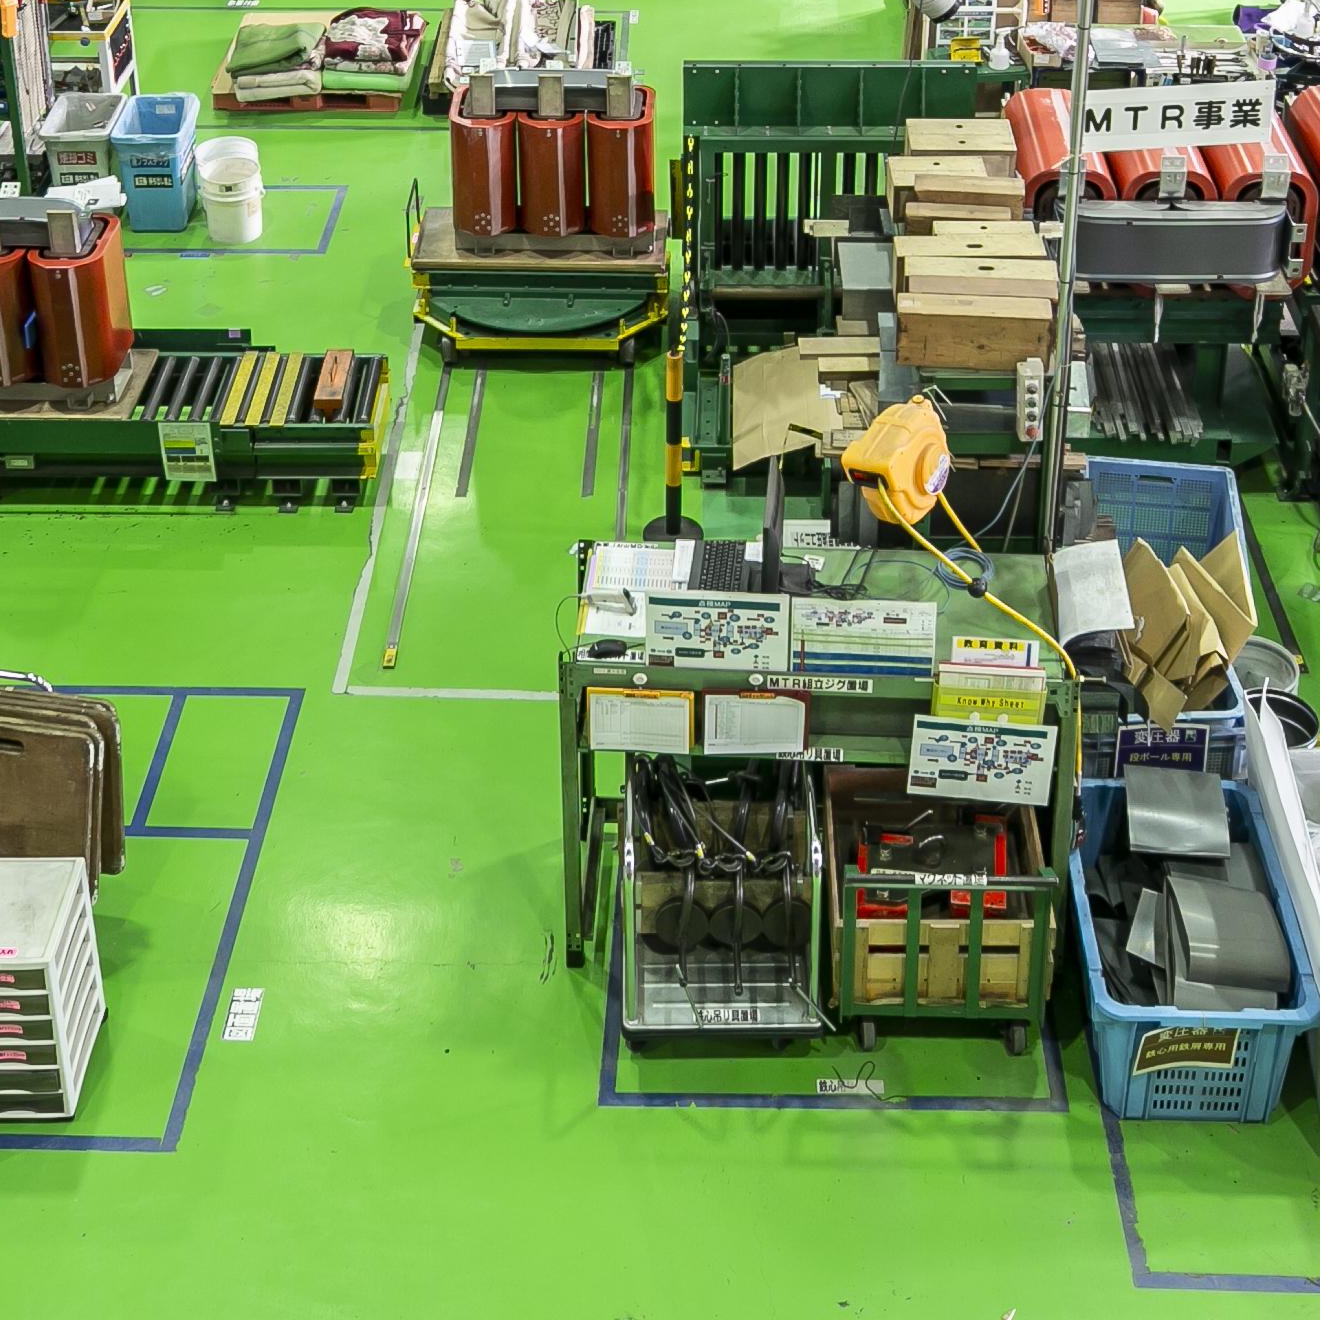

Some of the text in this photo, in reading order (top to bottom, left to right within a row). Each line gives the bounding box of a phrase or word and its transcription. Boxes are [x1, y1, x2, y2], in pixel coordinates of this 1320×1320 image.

[1085, 98, 1262, 133] MTR事業
[769, 677, 869, 691] MTR組立ジグ置場
[957, 697, 1024, 709] Know Why Sheet
